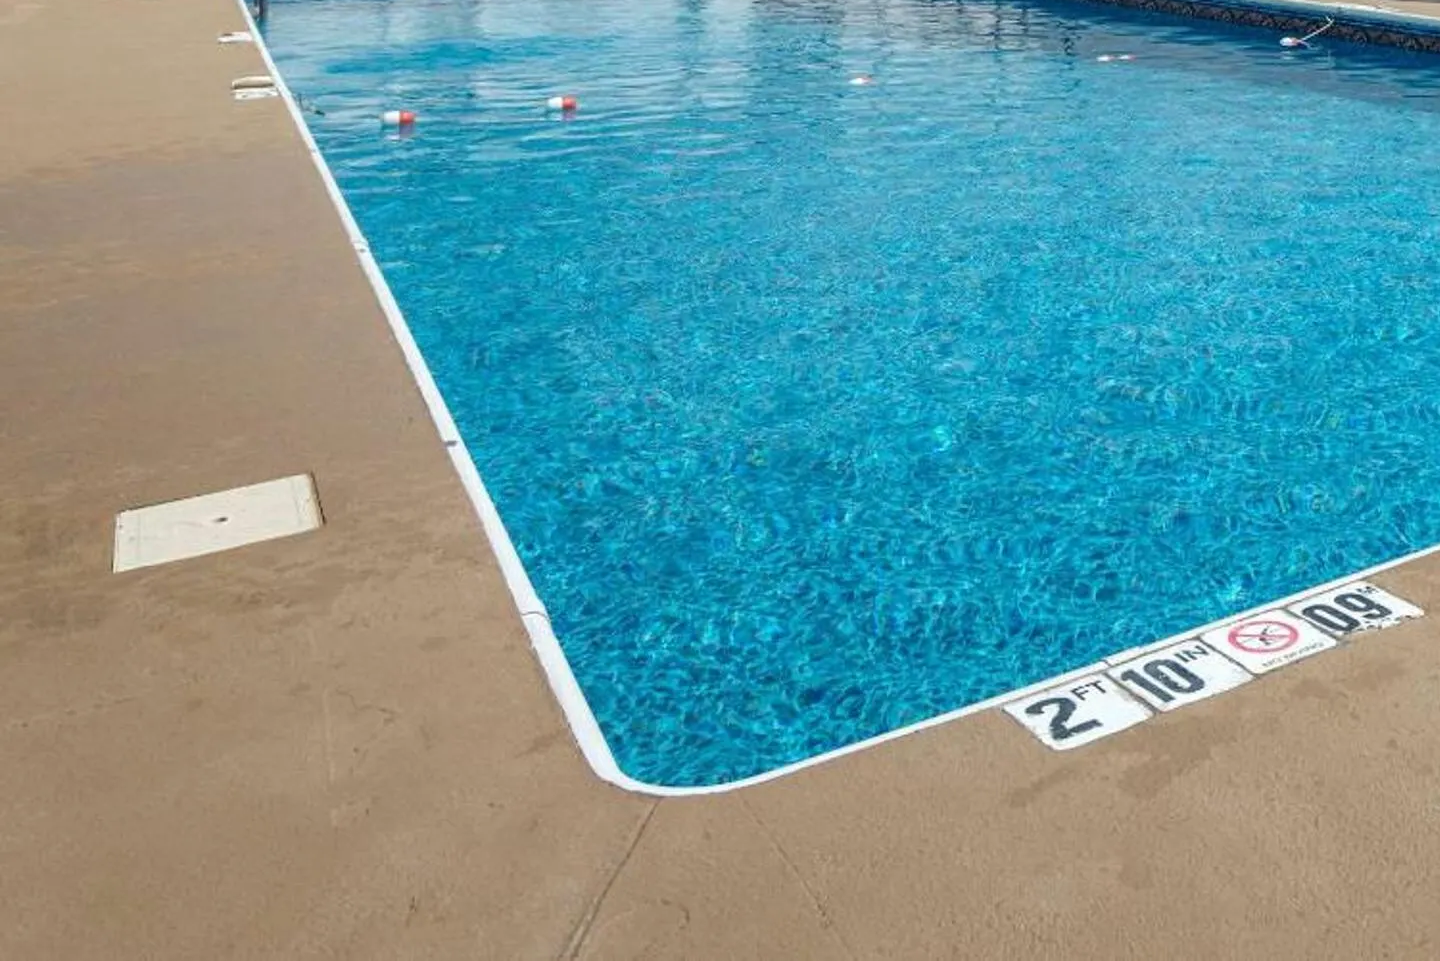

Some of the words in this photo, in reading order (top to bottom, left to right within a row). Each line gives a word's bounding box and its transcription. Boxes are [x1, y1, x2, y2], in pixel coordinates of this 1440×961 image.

[1302, 593, 1393, 632] 09
[1025, 697, 1103, 740] 2
[1071, 680, 1107, 700] FT
[1120, 658, 1205, 703] 10
[1174, 645, 1209, 663] IN
